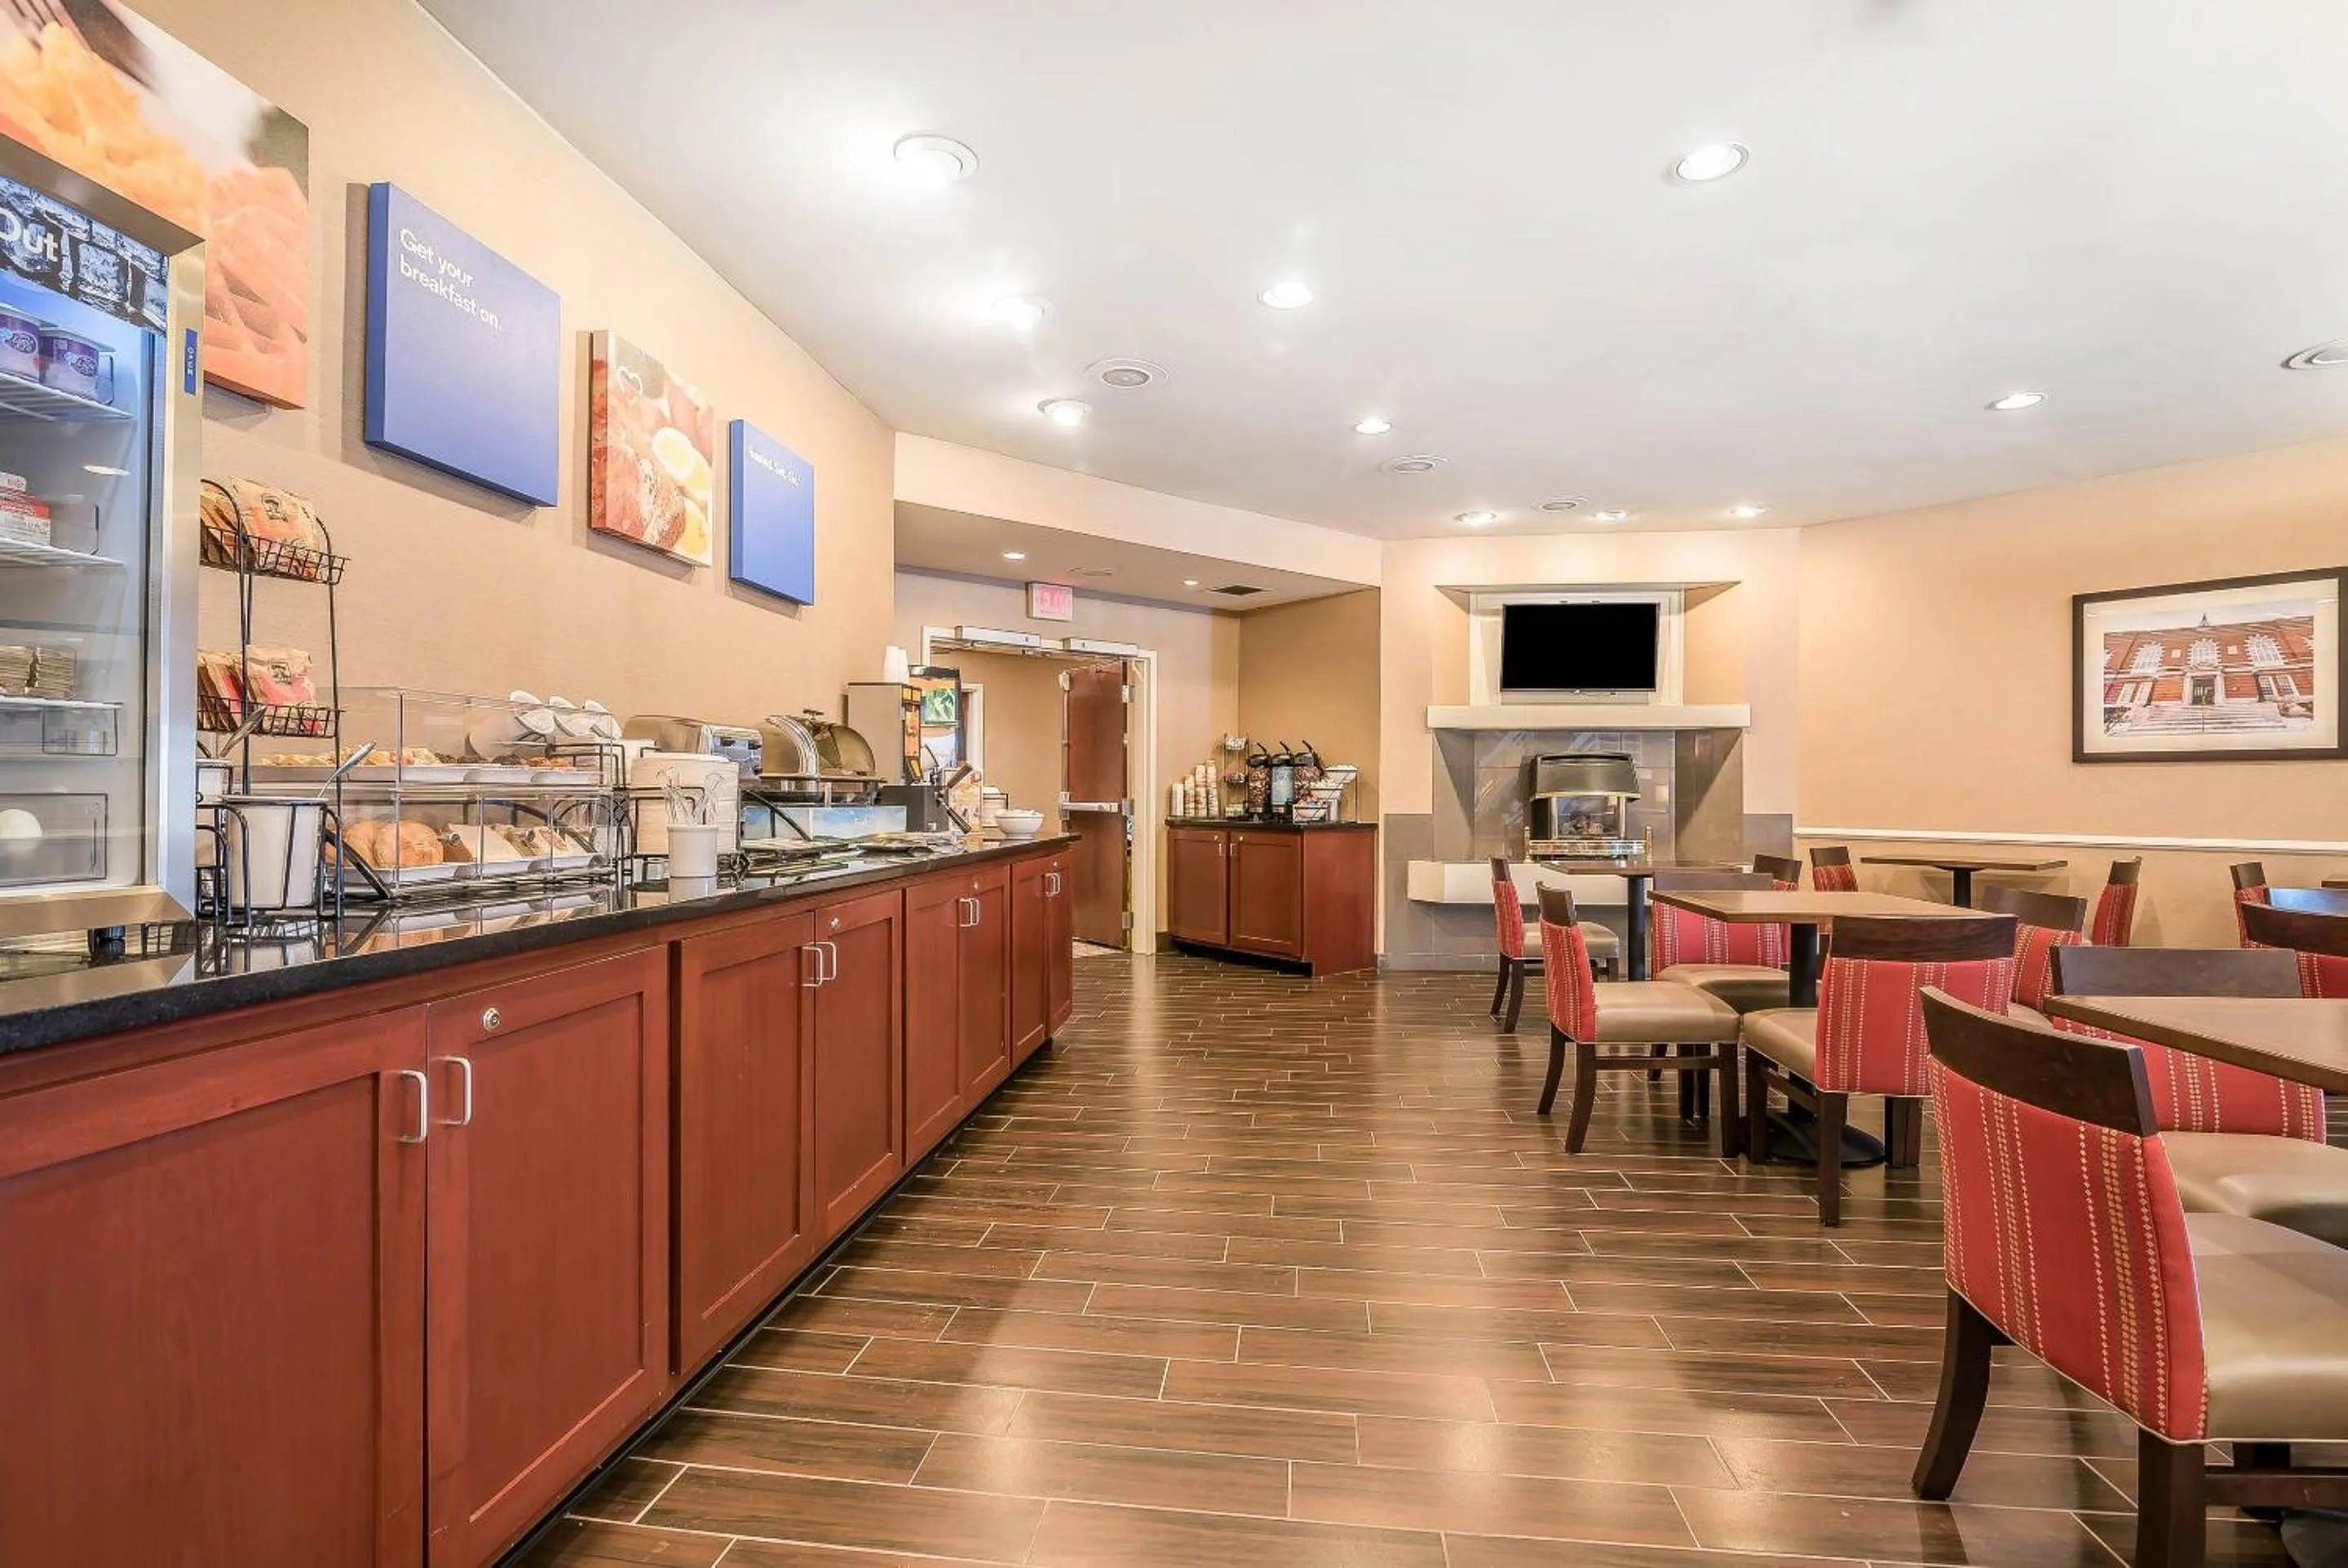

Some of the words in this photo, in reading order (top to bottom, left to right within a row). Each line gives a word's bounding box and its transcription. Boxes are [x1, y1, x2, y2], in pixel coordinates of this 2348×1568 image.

[400, 227, 434, 263] Get
[437, 256, 474, 287] your
[399, 253, 476, 314] breakfast
[479, 308, 502, 330] on.
